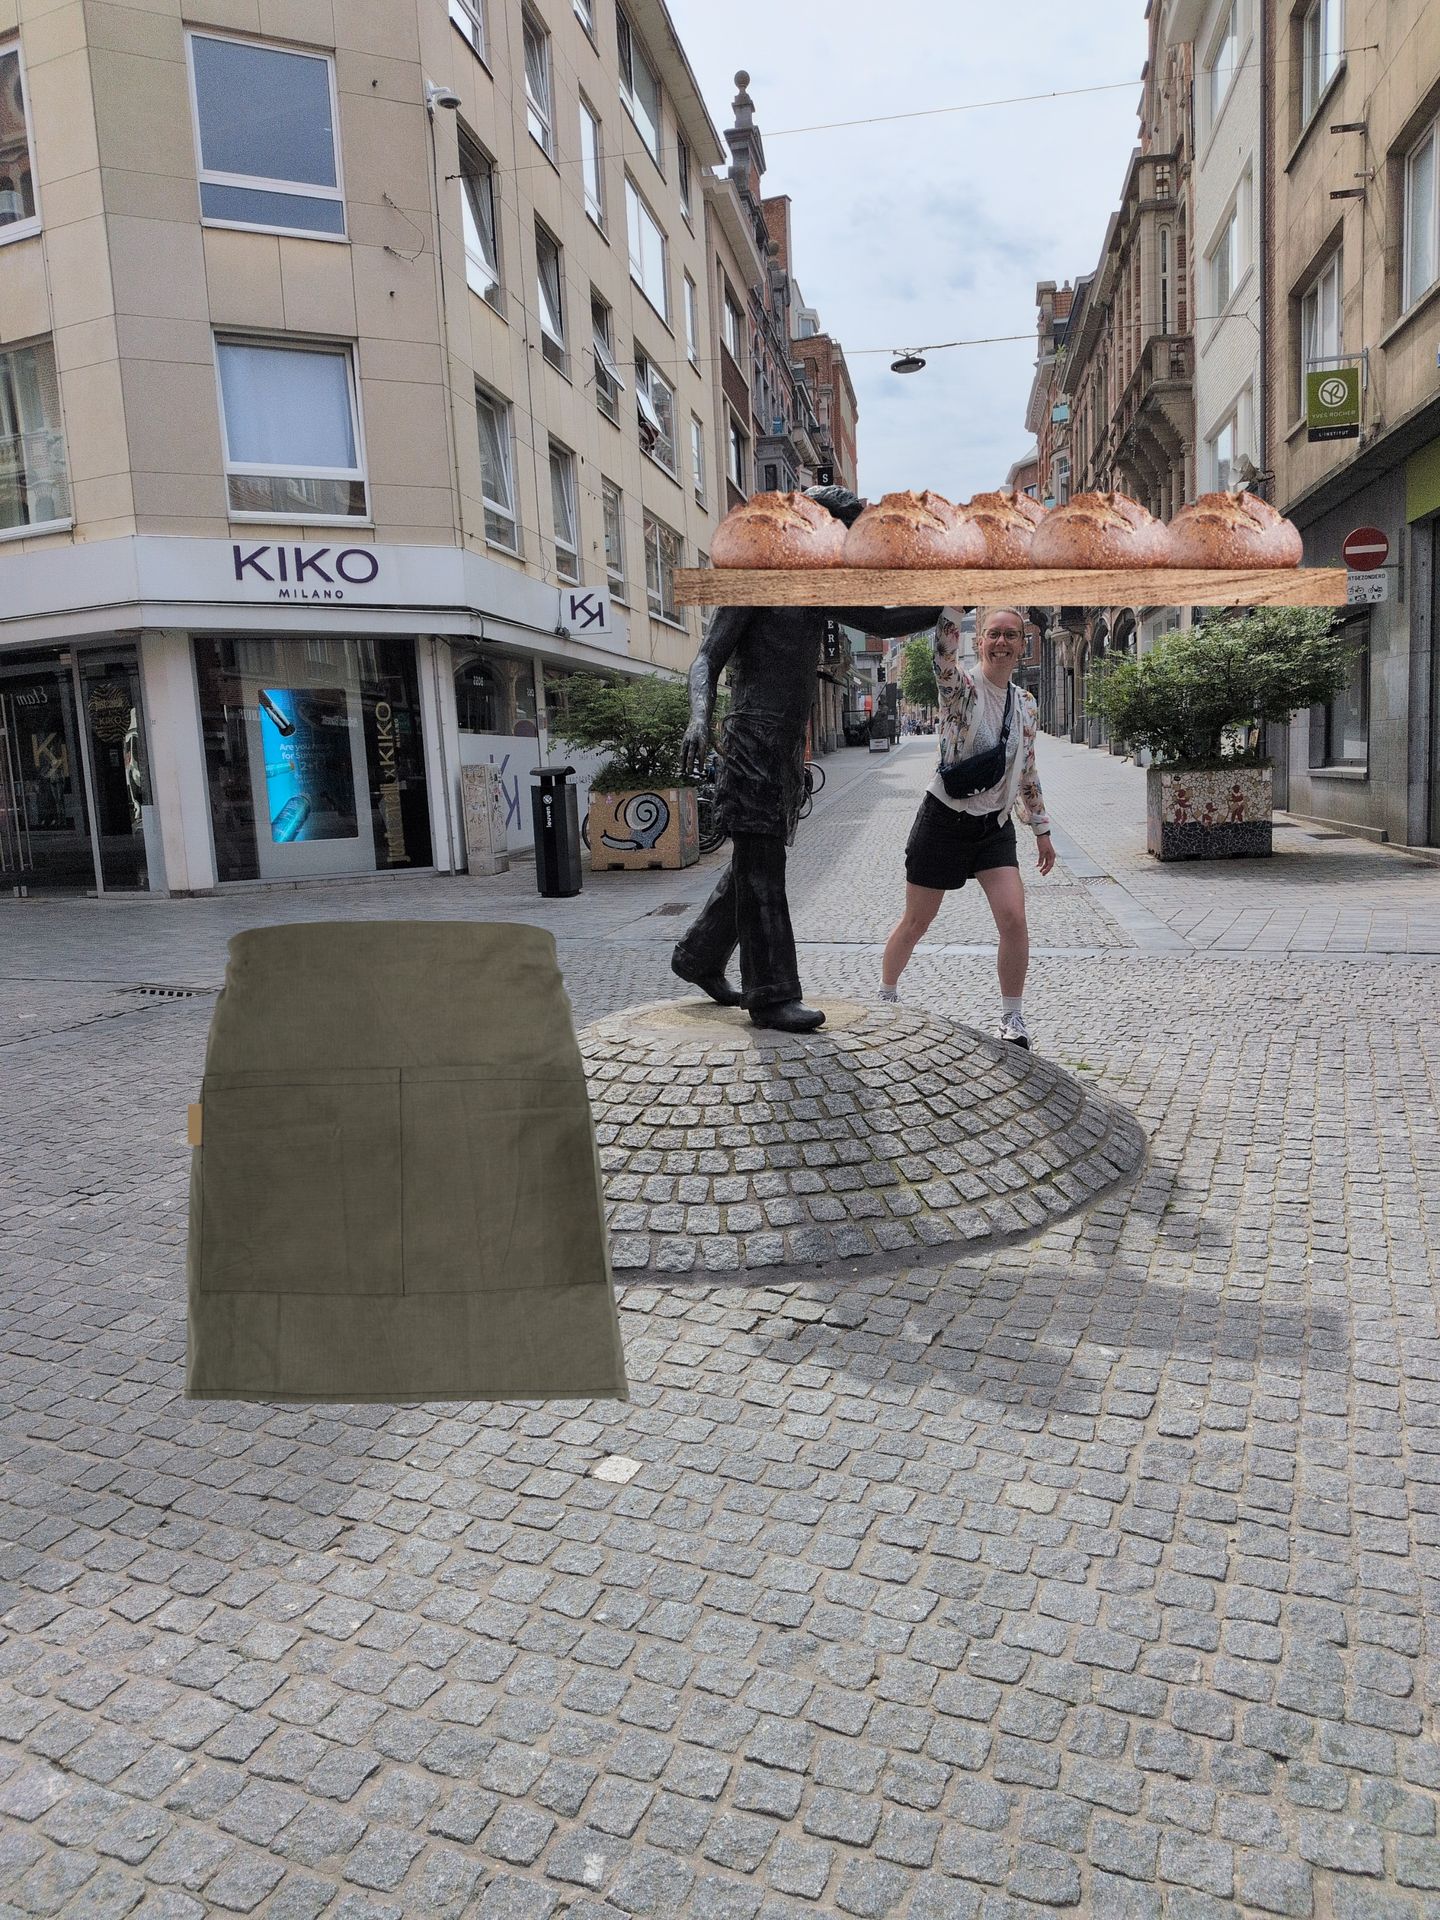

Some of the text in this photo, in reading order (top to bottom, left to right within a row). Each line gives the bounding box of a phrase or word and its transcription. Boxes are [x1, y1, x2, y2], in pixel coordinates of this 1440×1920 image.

[232, 545, 379, 584] KIKO
[279, 588, 344, 599] MILANO
[375, 702, 395, 766] KIKO
[279, 743, 294, 751] Are
[282, 752, 294, 760] for
